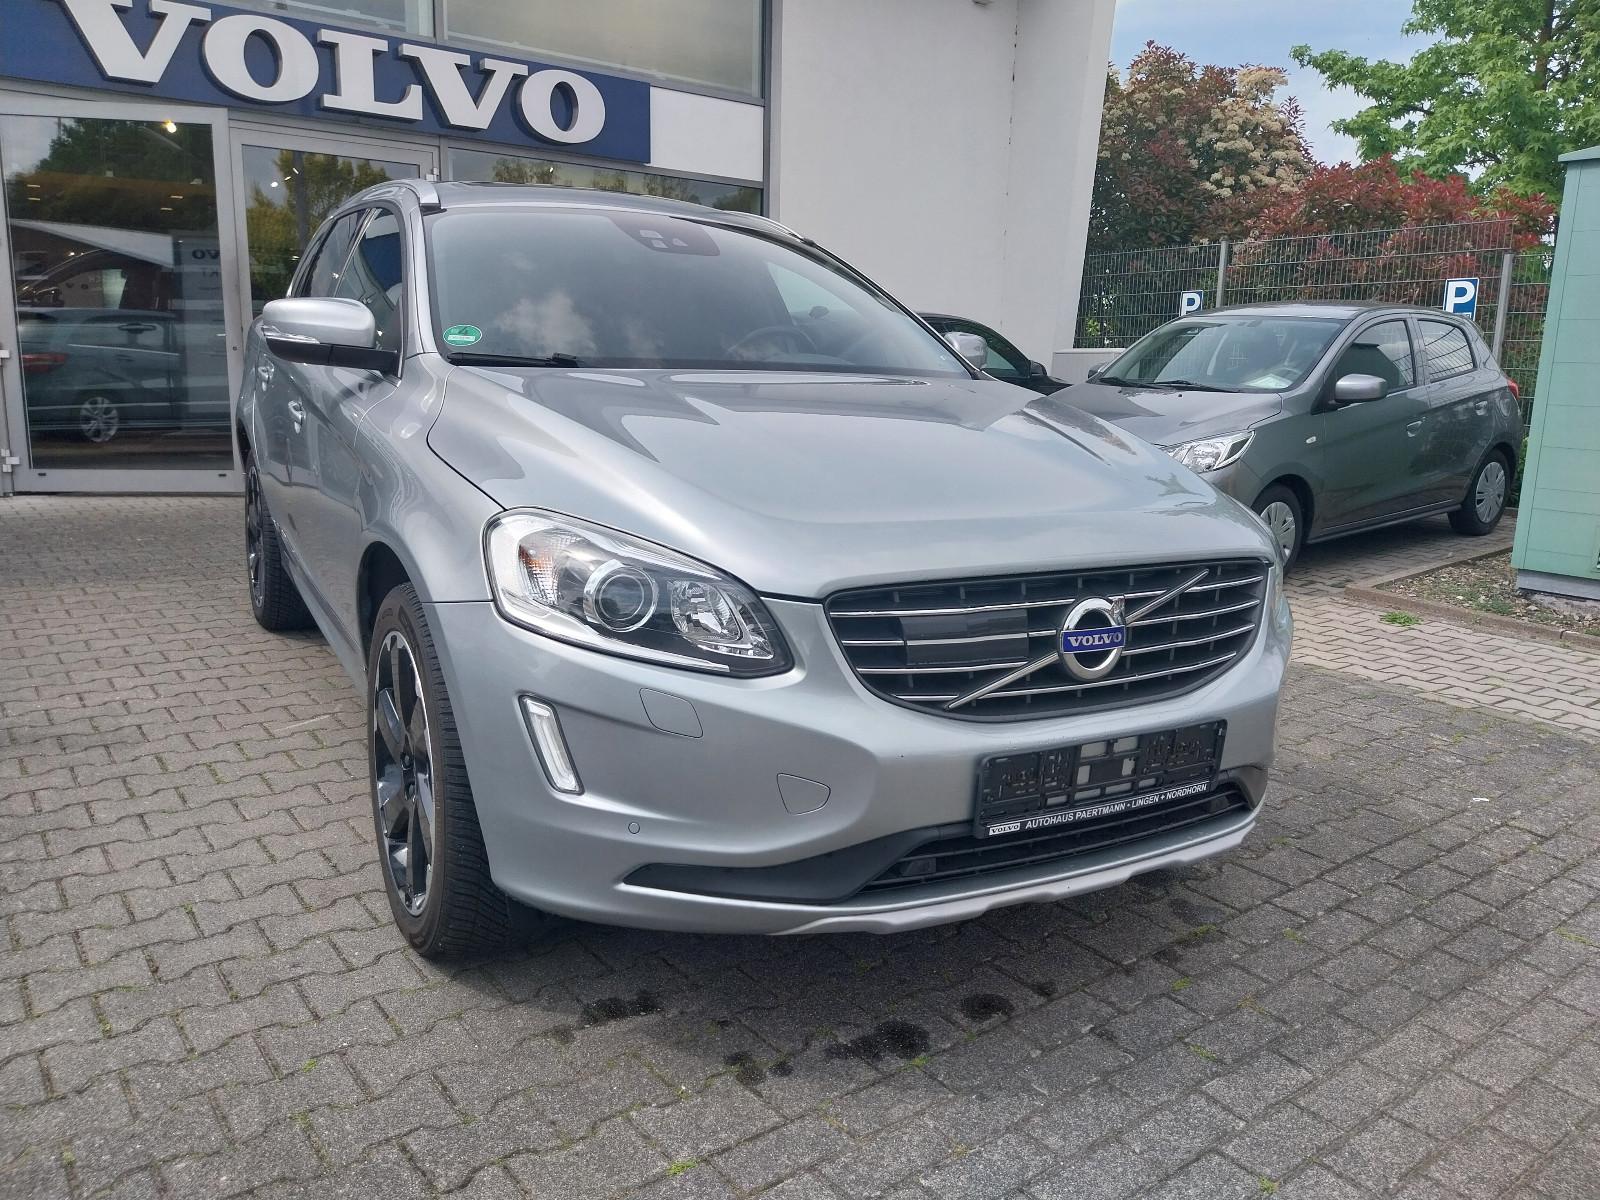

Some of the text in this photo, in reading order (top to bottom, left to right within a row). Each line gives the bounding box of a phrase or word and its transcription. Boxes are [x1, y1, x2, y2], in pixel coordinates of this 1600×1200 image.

[63, 0, 606, 145] VOLVO
[1181, 292, 1200, 317] P
[1446, 280, 1475, 313] P
[1067, 631, 1122, 647] VOLVO
[991, 823, 1019, 834] VOLVO
[1025, 812, 1074, 830] AUTOHAUS
[1075, 801, 1126, 820] PAERTMANN
[1131, 794, 1160, 808] LINGEN
[1166, 783, 1207, 800] NORDHORN
